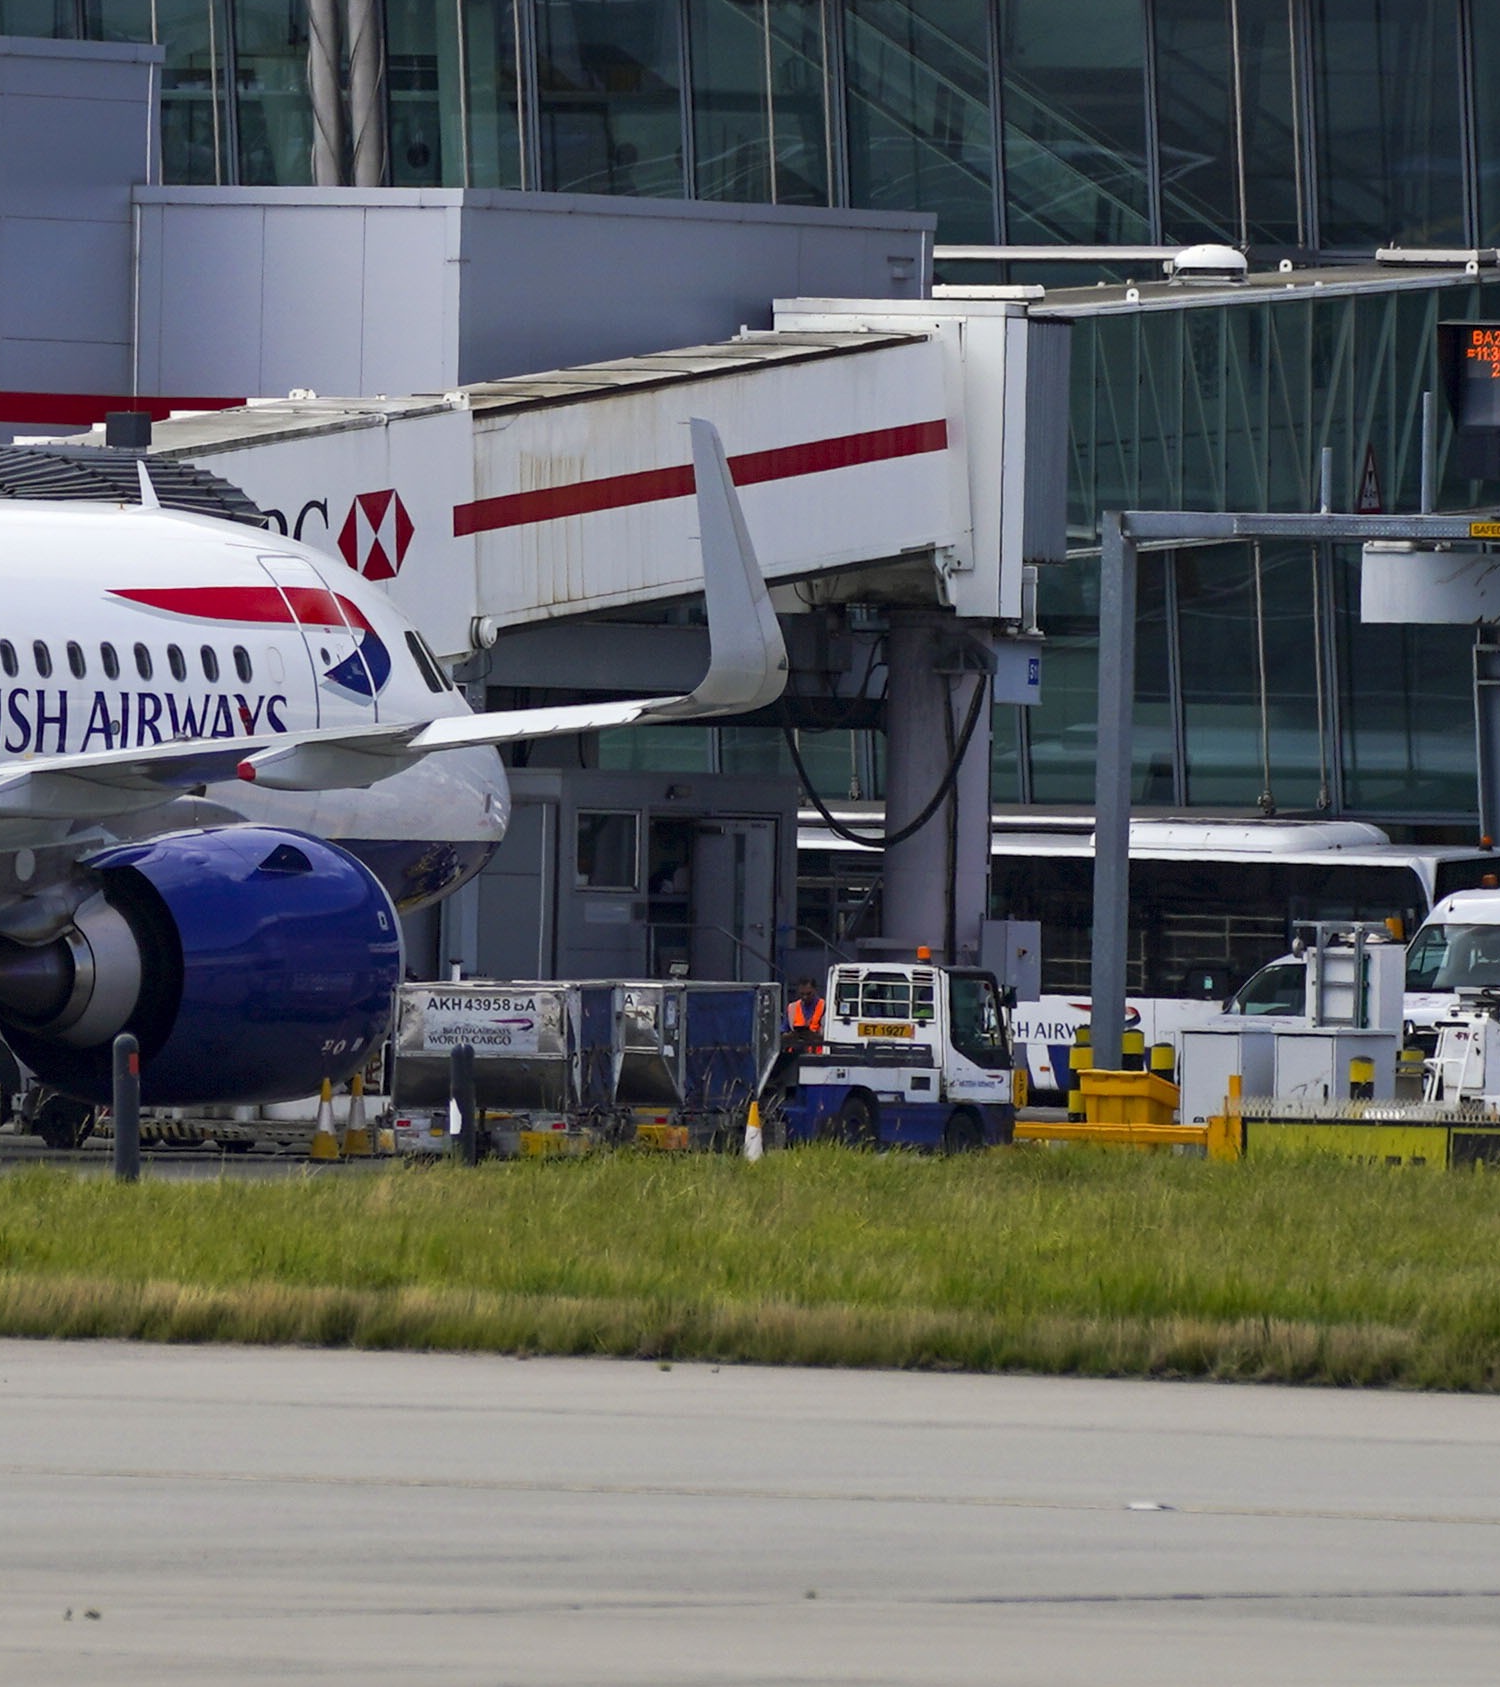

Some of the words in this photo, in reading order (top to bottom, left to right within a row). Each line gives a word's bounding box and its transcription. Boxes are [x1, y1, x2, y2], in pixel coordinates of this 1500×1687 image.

[79, 690, 290, 752] AIRWAYS
[426, 997, 462, 1012] AKH
[464, 998, 511, 1012] 43958
[863, 1023, 879, 1036] ET
[880, 1024, 906, 1036] 1927
[428, 1034, 467, 1046] WORLD
[470, 1035, 512, 1046] CARGO
